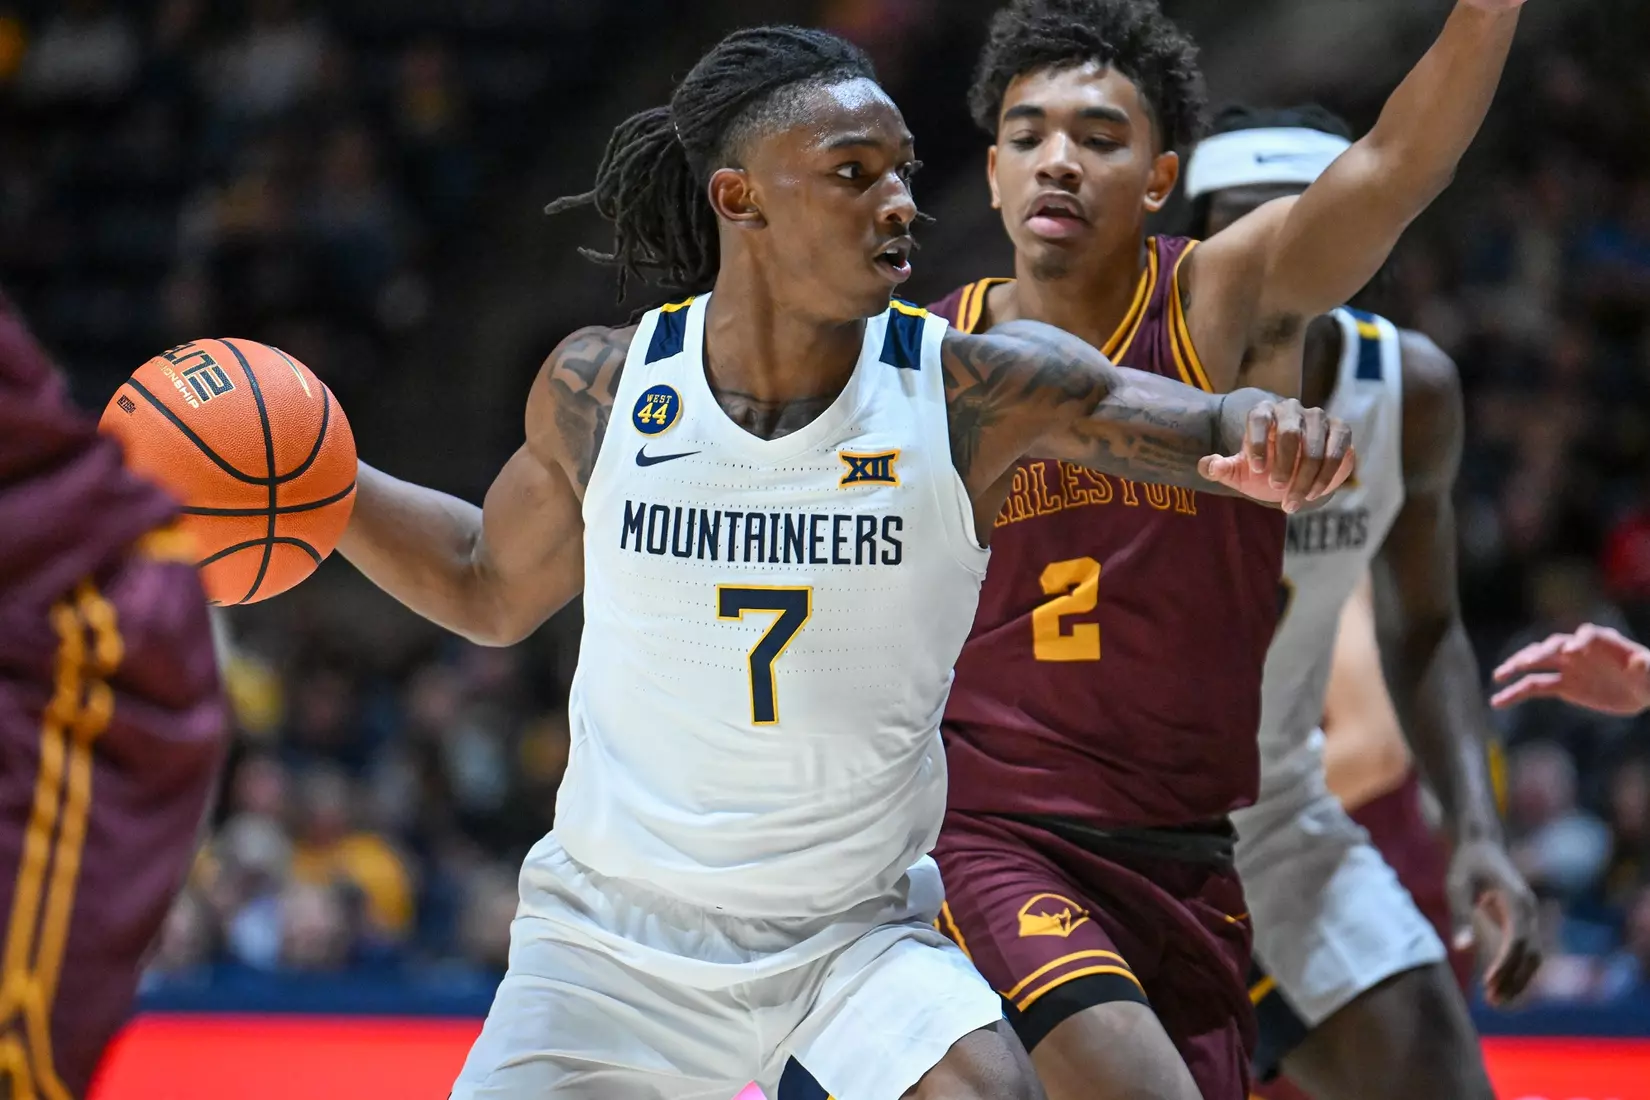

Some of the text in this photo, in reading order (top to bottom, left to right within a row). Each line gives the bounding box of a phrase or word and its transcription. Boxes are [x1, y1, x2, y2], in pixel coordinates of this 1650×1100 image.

[637, 402, 669, 425] 44
[646, 394, 673, 404] WEST
[993, 460, 1198, 528] RLESTON
[620, 500, 904, 566] MOUNTAINEERS
[1032, 556, 1102, 662] 2
[717, 583, 813, 727] 7
